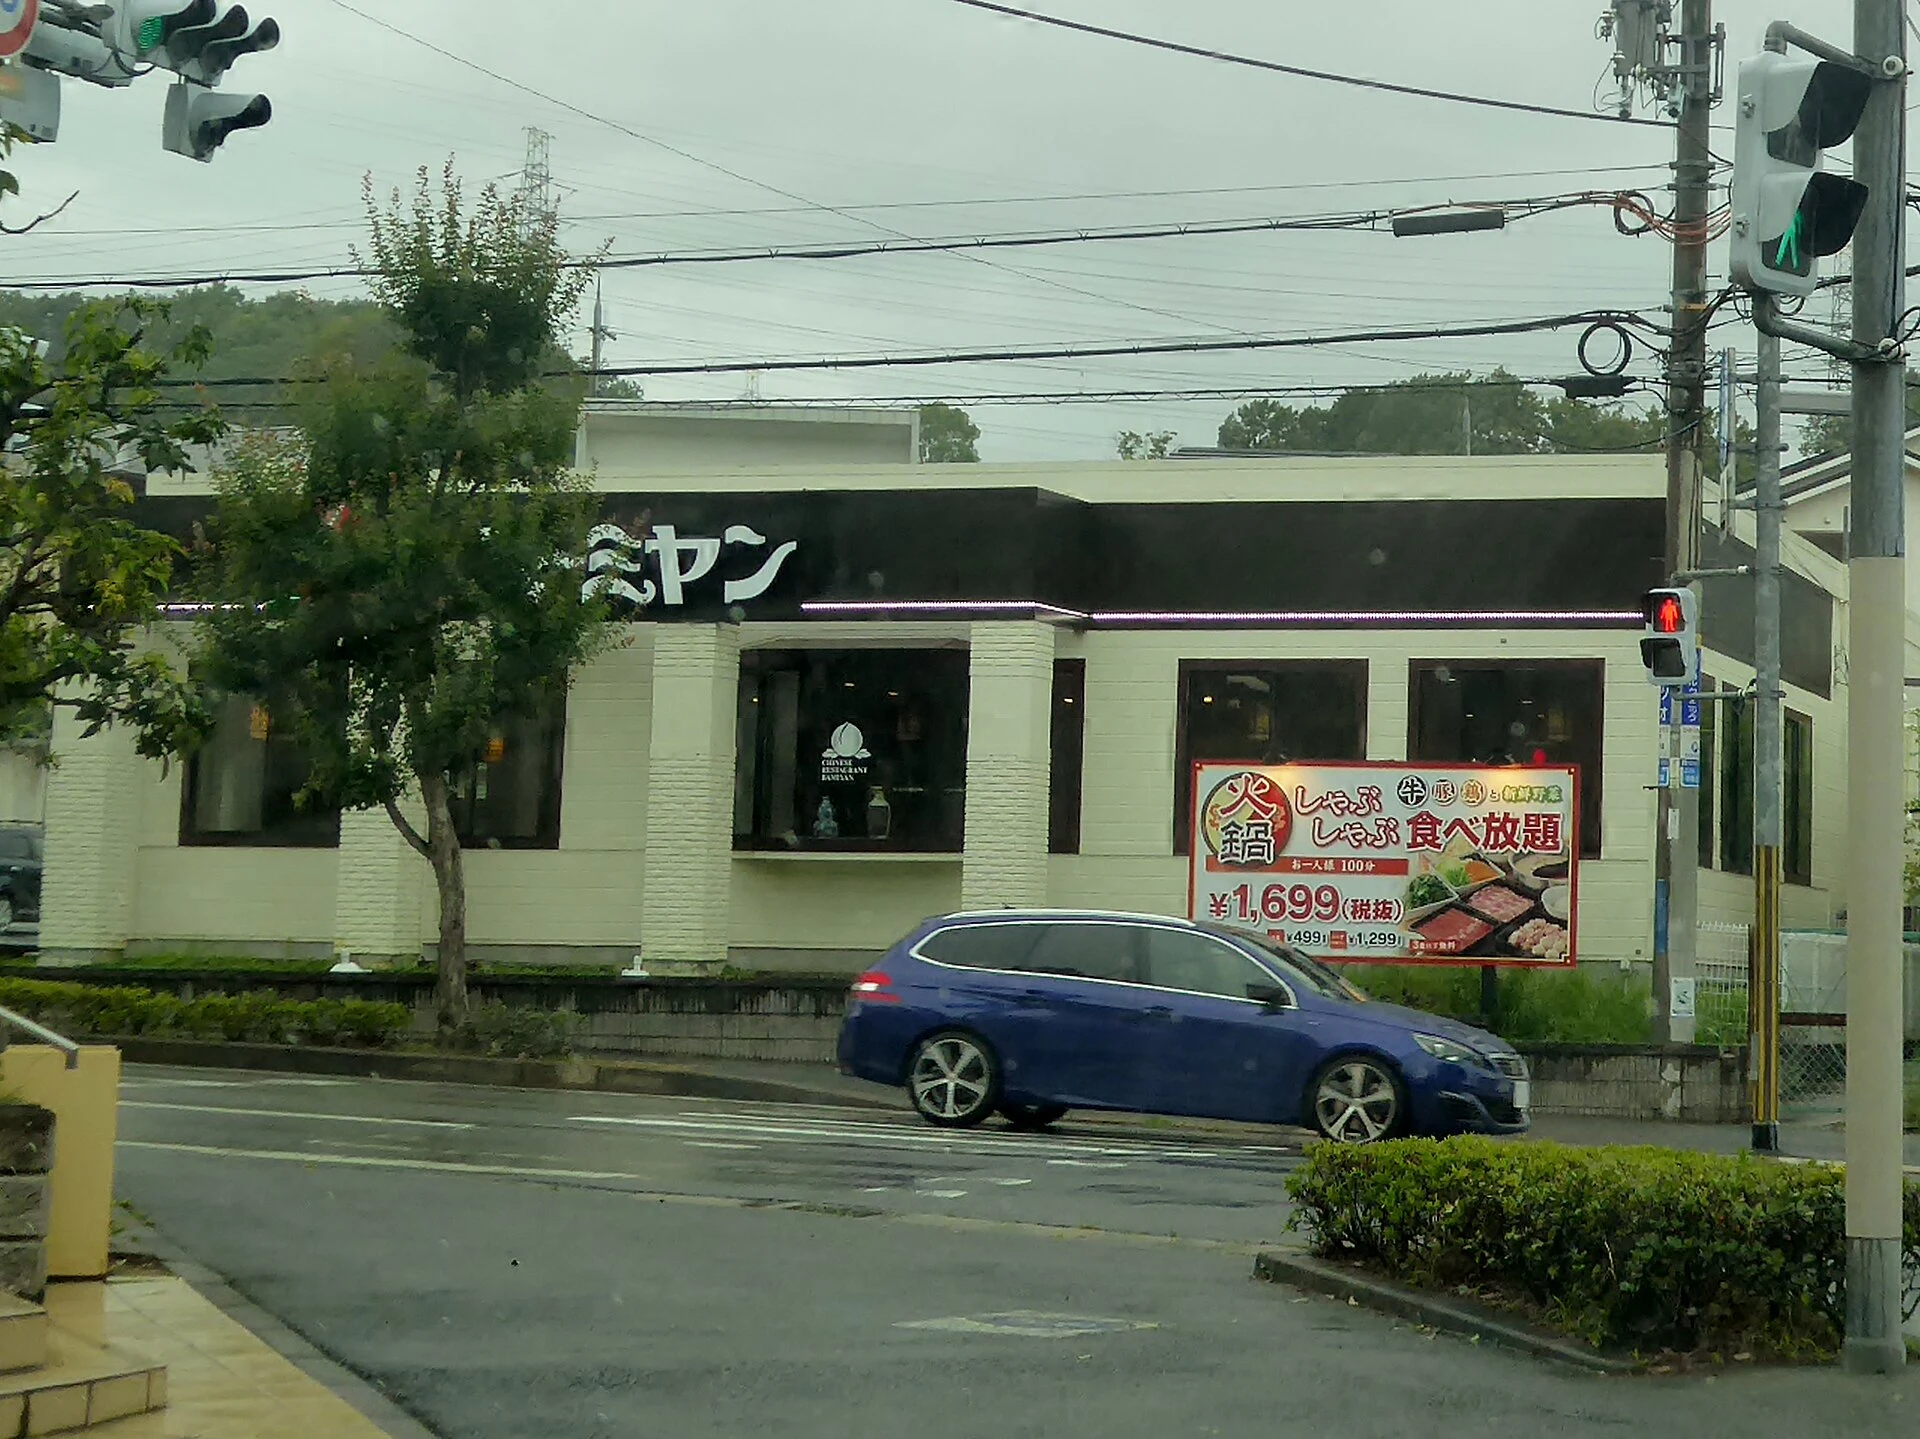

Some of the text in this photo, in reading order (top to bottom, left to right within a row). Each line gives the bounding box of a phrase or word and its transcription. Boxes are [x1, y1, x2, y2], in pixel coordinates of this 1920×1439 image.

[540, 524, 797, 605] ミヤン
[1219, 773, 1277, 865] 火鍋
[1295, 785, 1383, 817] しゃぶ
[1312, 817, 1401, 849] しゃぶ
[1405, 810, 1563, 853] 食べ放題
